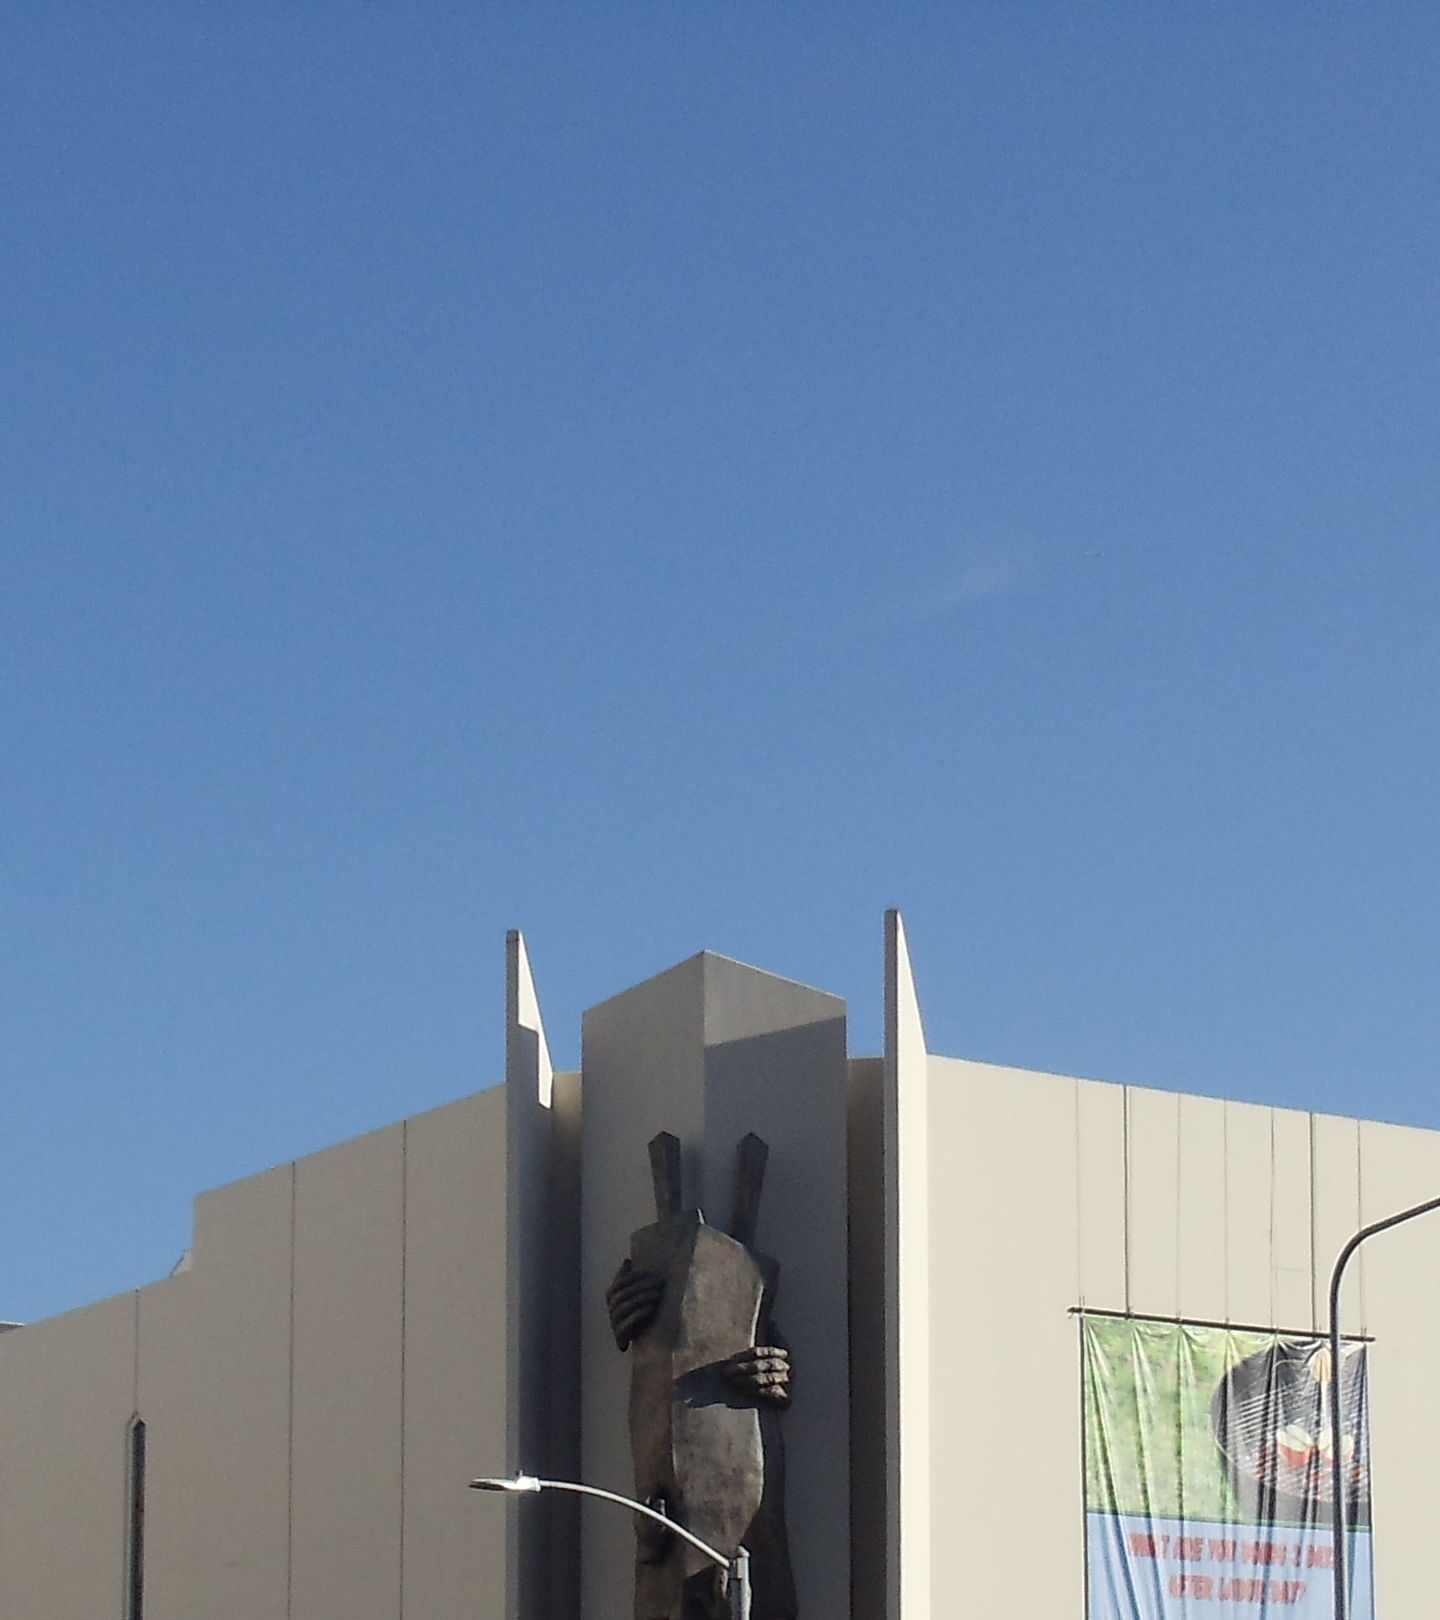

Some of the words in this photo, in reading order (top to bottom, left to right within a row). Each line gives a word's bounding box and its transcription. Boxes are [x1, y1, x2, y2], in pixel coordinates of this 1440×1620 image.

[1173, 1536, 1203, 1561] ARE
[1208, 1538, 1238, 1562] YOU
[1168, 1574, 1213, 1600] AFTER
[1219, 1576, 1266, 1604] LABOR
